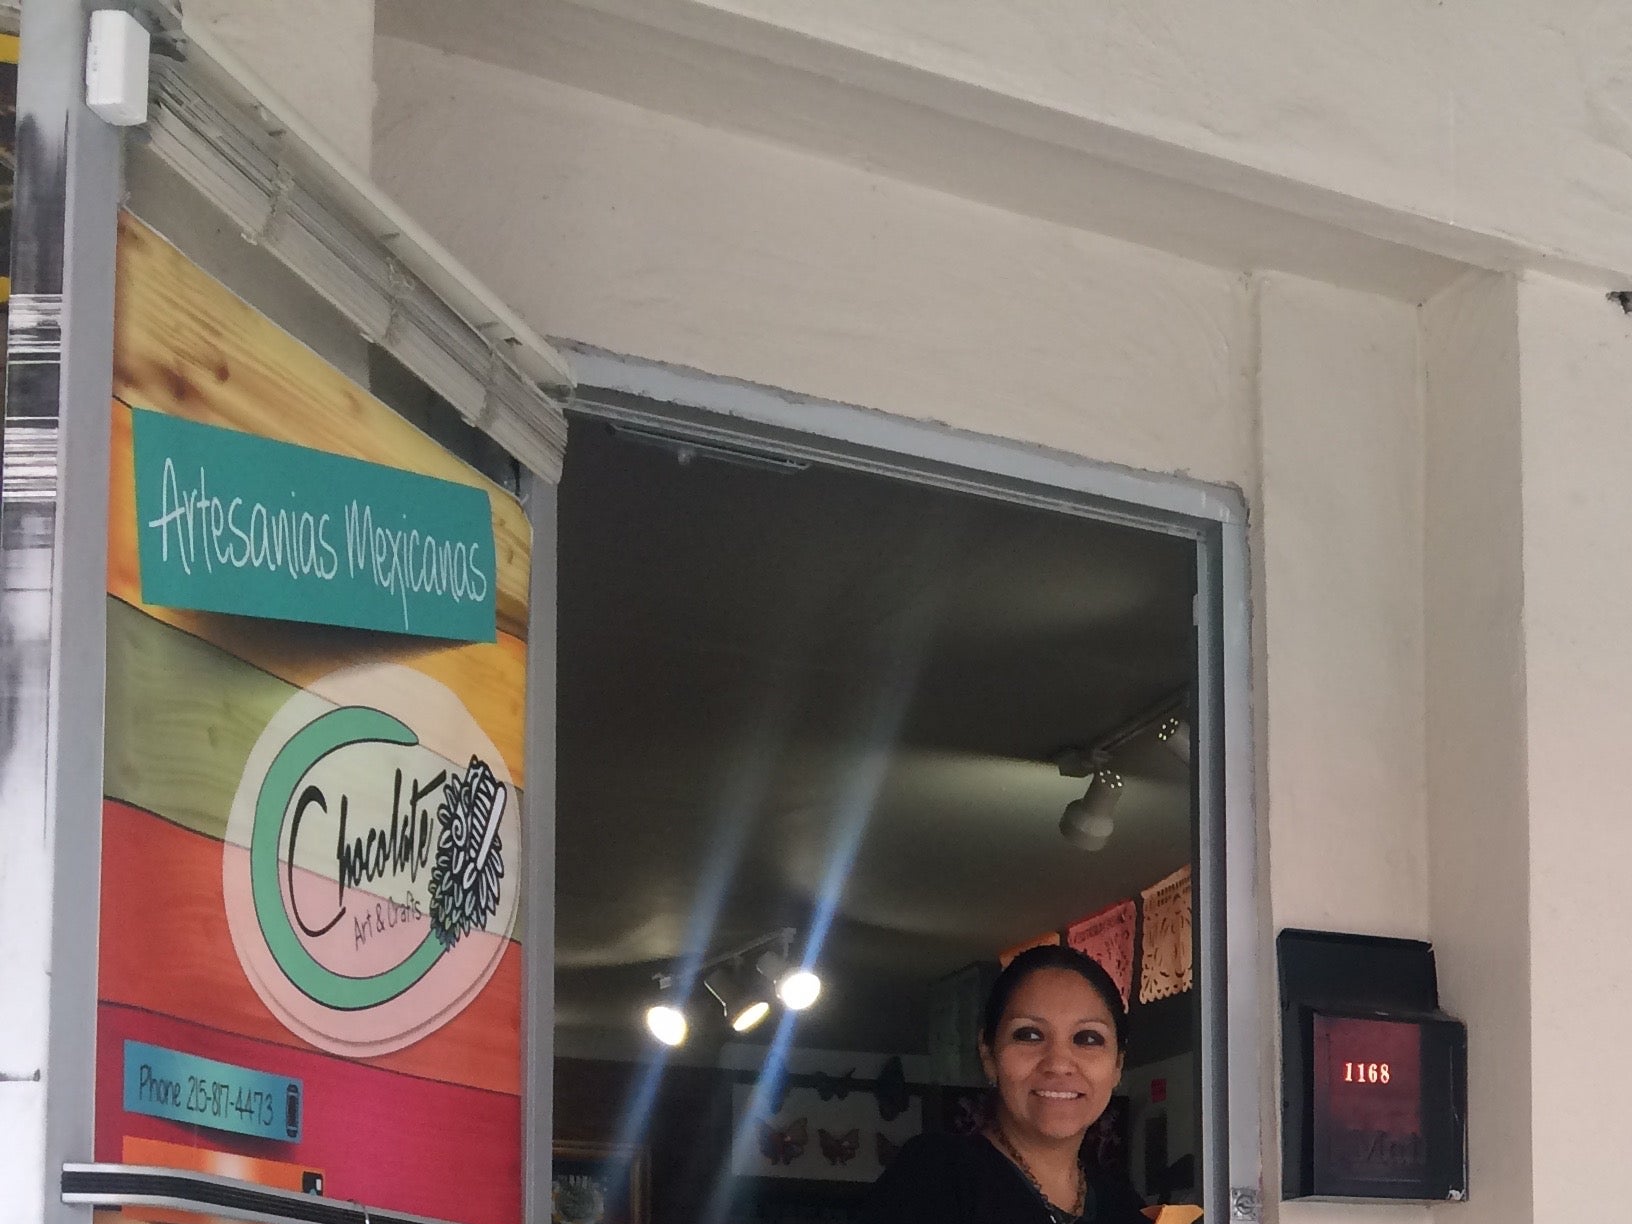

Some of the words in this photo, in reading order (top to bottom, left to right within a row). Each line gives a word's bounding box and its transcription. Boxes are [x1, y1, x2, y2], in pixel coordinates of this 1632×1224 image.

[149, 457, 338, 580] Artesanias
[344, 499, 488, 631] Mexicanas
[288, 767, 447, 938] Chocolate
[354, 913, 374, 951] Art
[376, 904, 386, 933] &
[387, 891, 423, 928] Crafts
[139, 1064, 182, 1108] Phone
[186, 1075, 274, 1126] 215-817-4473
[1344, 1062, 1391, 1084] 1168
